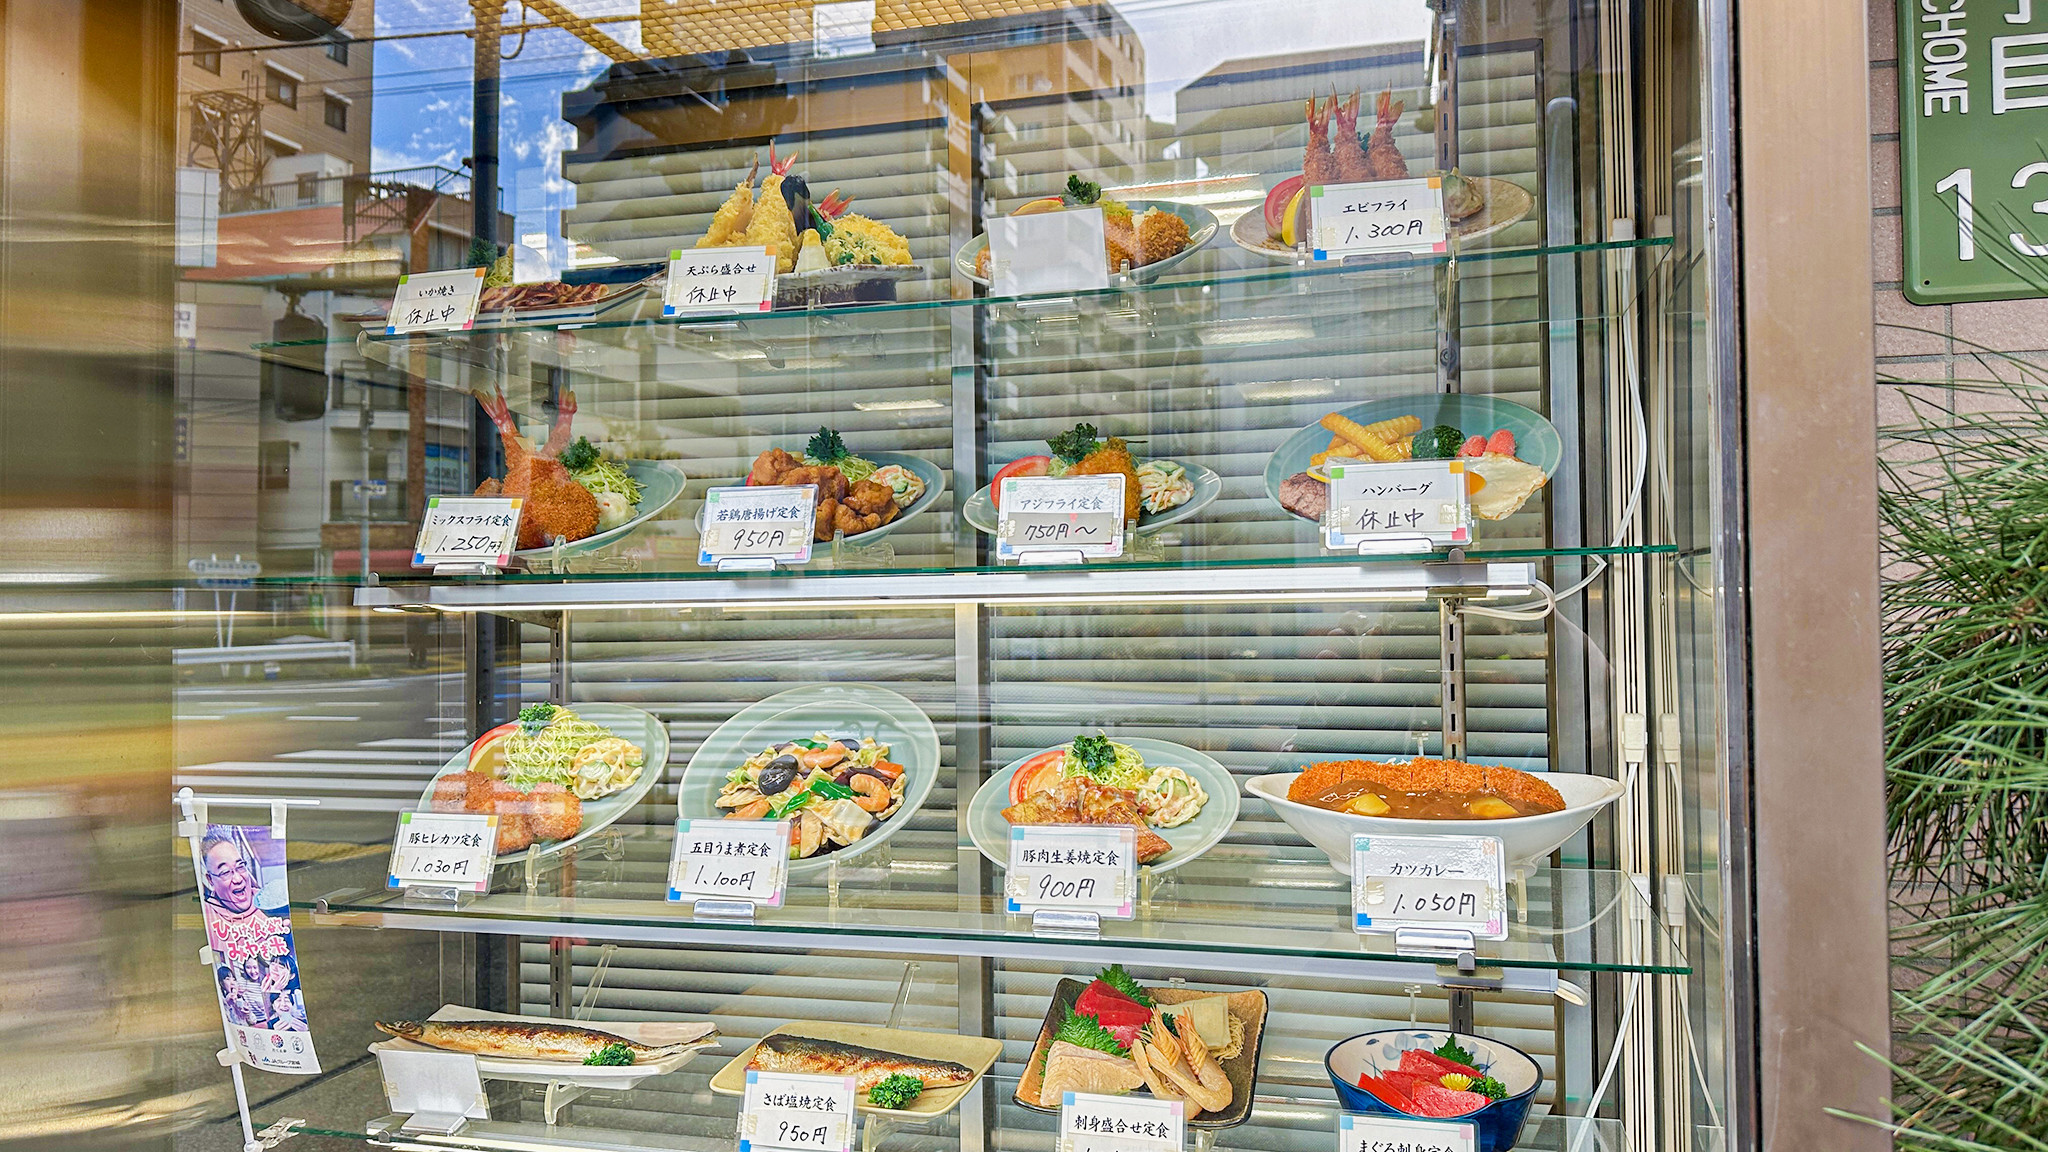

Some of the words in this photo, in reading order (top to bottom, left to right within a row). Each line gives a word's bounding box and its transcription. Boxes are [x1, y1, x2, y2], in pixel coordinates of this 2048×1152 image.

[1342, 198, 1408, 214] エビフライ
[418, 284, 455, 297] いか焼き
[686, 285, 737, 304] 休止中
[405, 304, 455, 325] 休止中
[1361, 481, 1433, 496] ハンバーグ
[1020, 496, 1104, 511] アジフライ定食
[432, 514, 513, 527] ミックスフライ定食
[716, 505, 801, 521] 若鶏唐揚げ定食
[1356, 508, 1424, 530] 休止中
[733, 528, 785, 551] 950円
[408, 832, 482, 848] 豚ヒレカツ定食
[690, 841, 772, 858] 五目うま煮定食
[1022, 848, 1120, 866] 豚肉生姜焼定食
[1390, 862, 1465, 877] カツカレー
[1039, 874, 1096, 900] 900円
[227, 936, 288, 962] みやぎ米
[763, 1092, 837, 1112] さば塩焼定食
[778, 1121, 828, 1145] 950円
[1074, 1114, 1170, 1139] 刺身盛合せ定食
